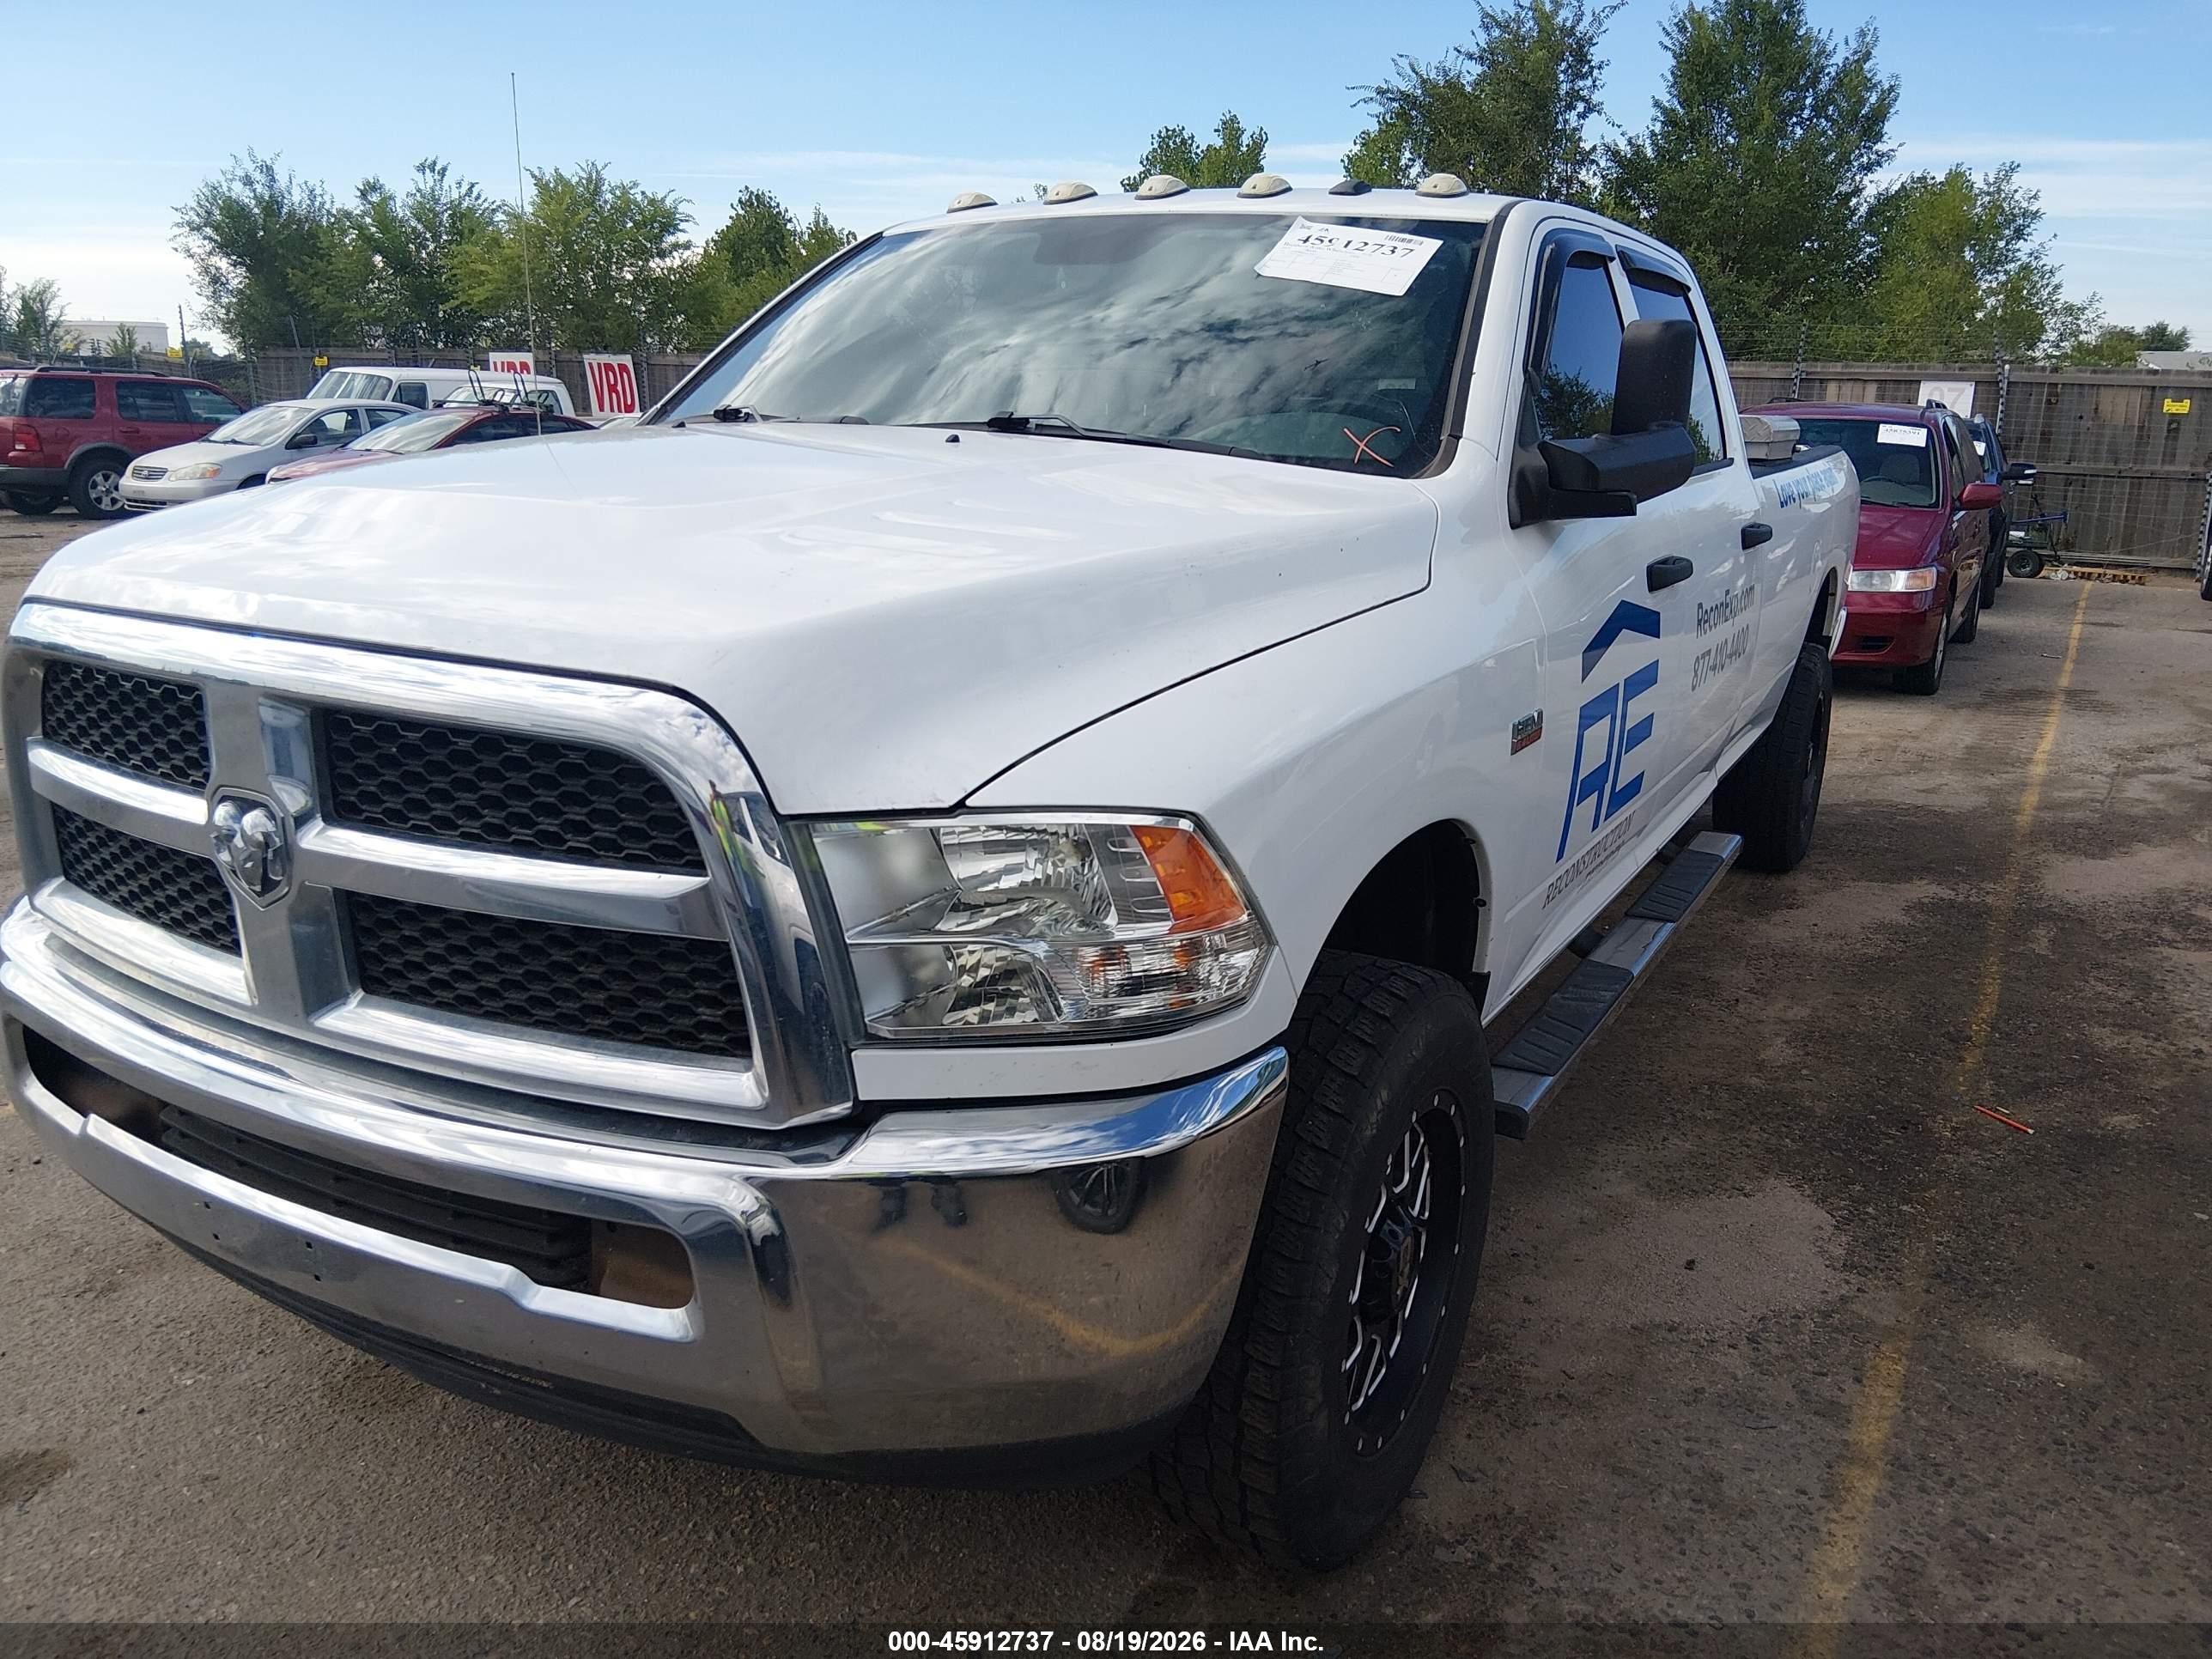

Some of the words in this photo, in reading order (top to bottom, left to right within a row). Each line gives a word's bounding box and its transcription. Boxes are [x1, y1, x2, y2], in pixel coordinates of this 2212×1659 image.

[588, 362, 637, 414] VRD
[1696, 583, 1755, 639] ReconExp.com
[1691, 623, 1749, 692] 877-410-4400
[1542, 810, 1636, 910] RECONSTRUCTION
